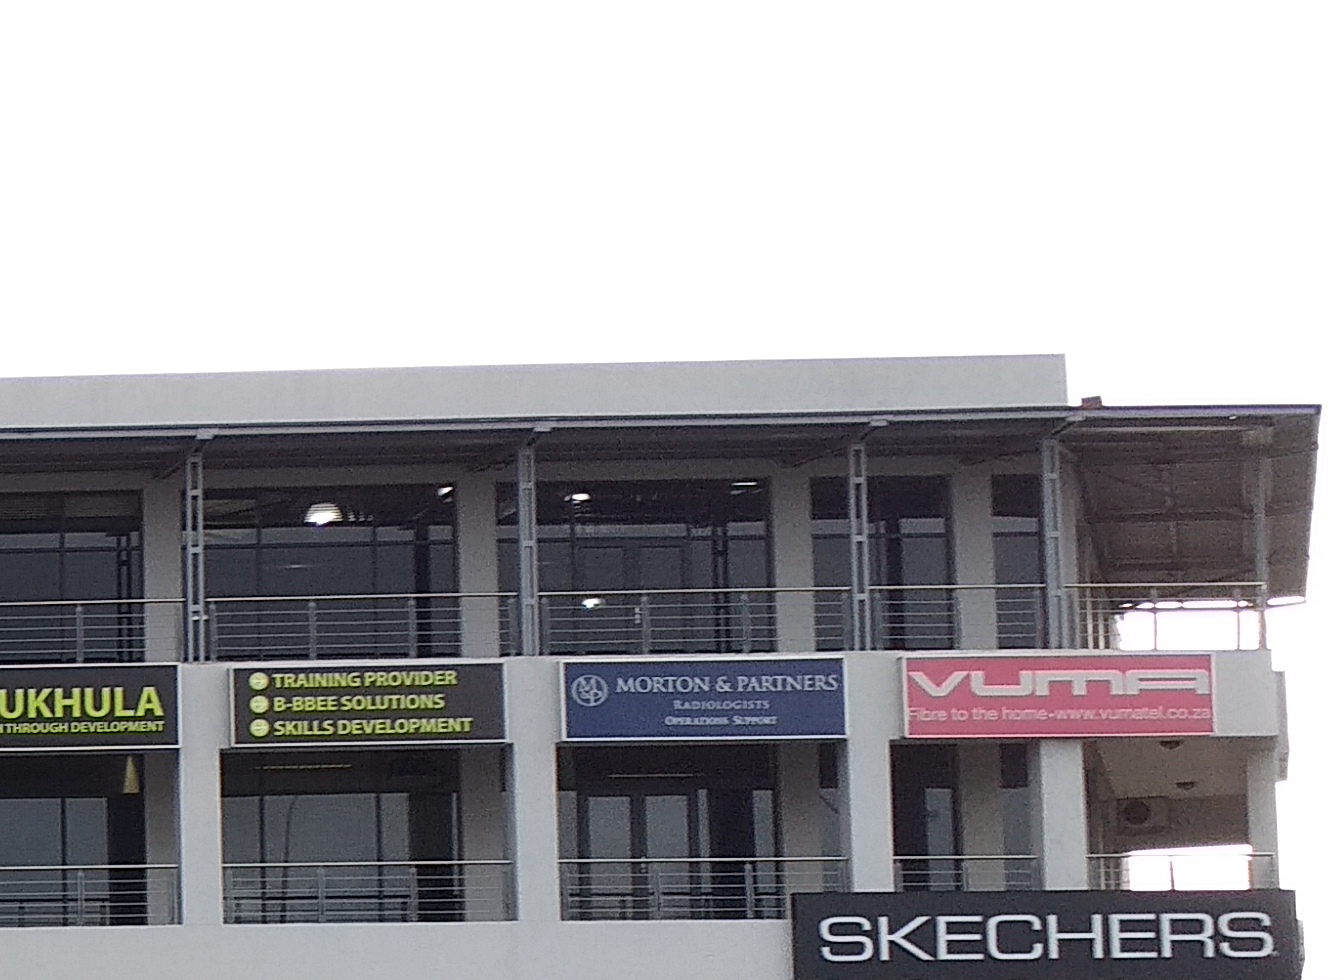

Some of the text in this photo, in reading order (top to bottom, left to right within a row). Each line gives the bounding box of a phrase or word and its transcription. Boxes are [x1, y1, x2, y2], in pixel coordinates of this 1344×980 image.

[273, 670, 458, 688] TRAINING PROVIDER
[615, 674, 839, 693] MORTON & PARTNERS
[908, 670, 1210, 697] VUMA
[273, 694, 446, 712] B-BBEE SOLUTIONS
[951, 708, 968, 721] to
[972, 707, 999, 721] the
[5, 722, 68, 734] THROUGH
[70, 720, 165, 733] DEVELOPMENT
[273, 717, 474, 736] SKILLS DEVELOPMENT
[818, 912, 1276, 962] SKECHERS
